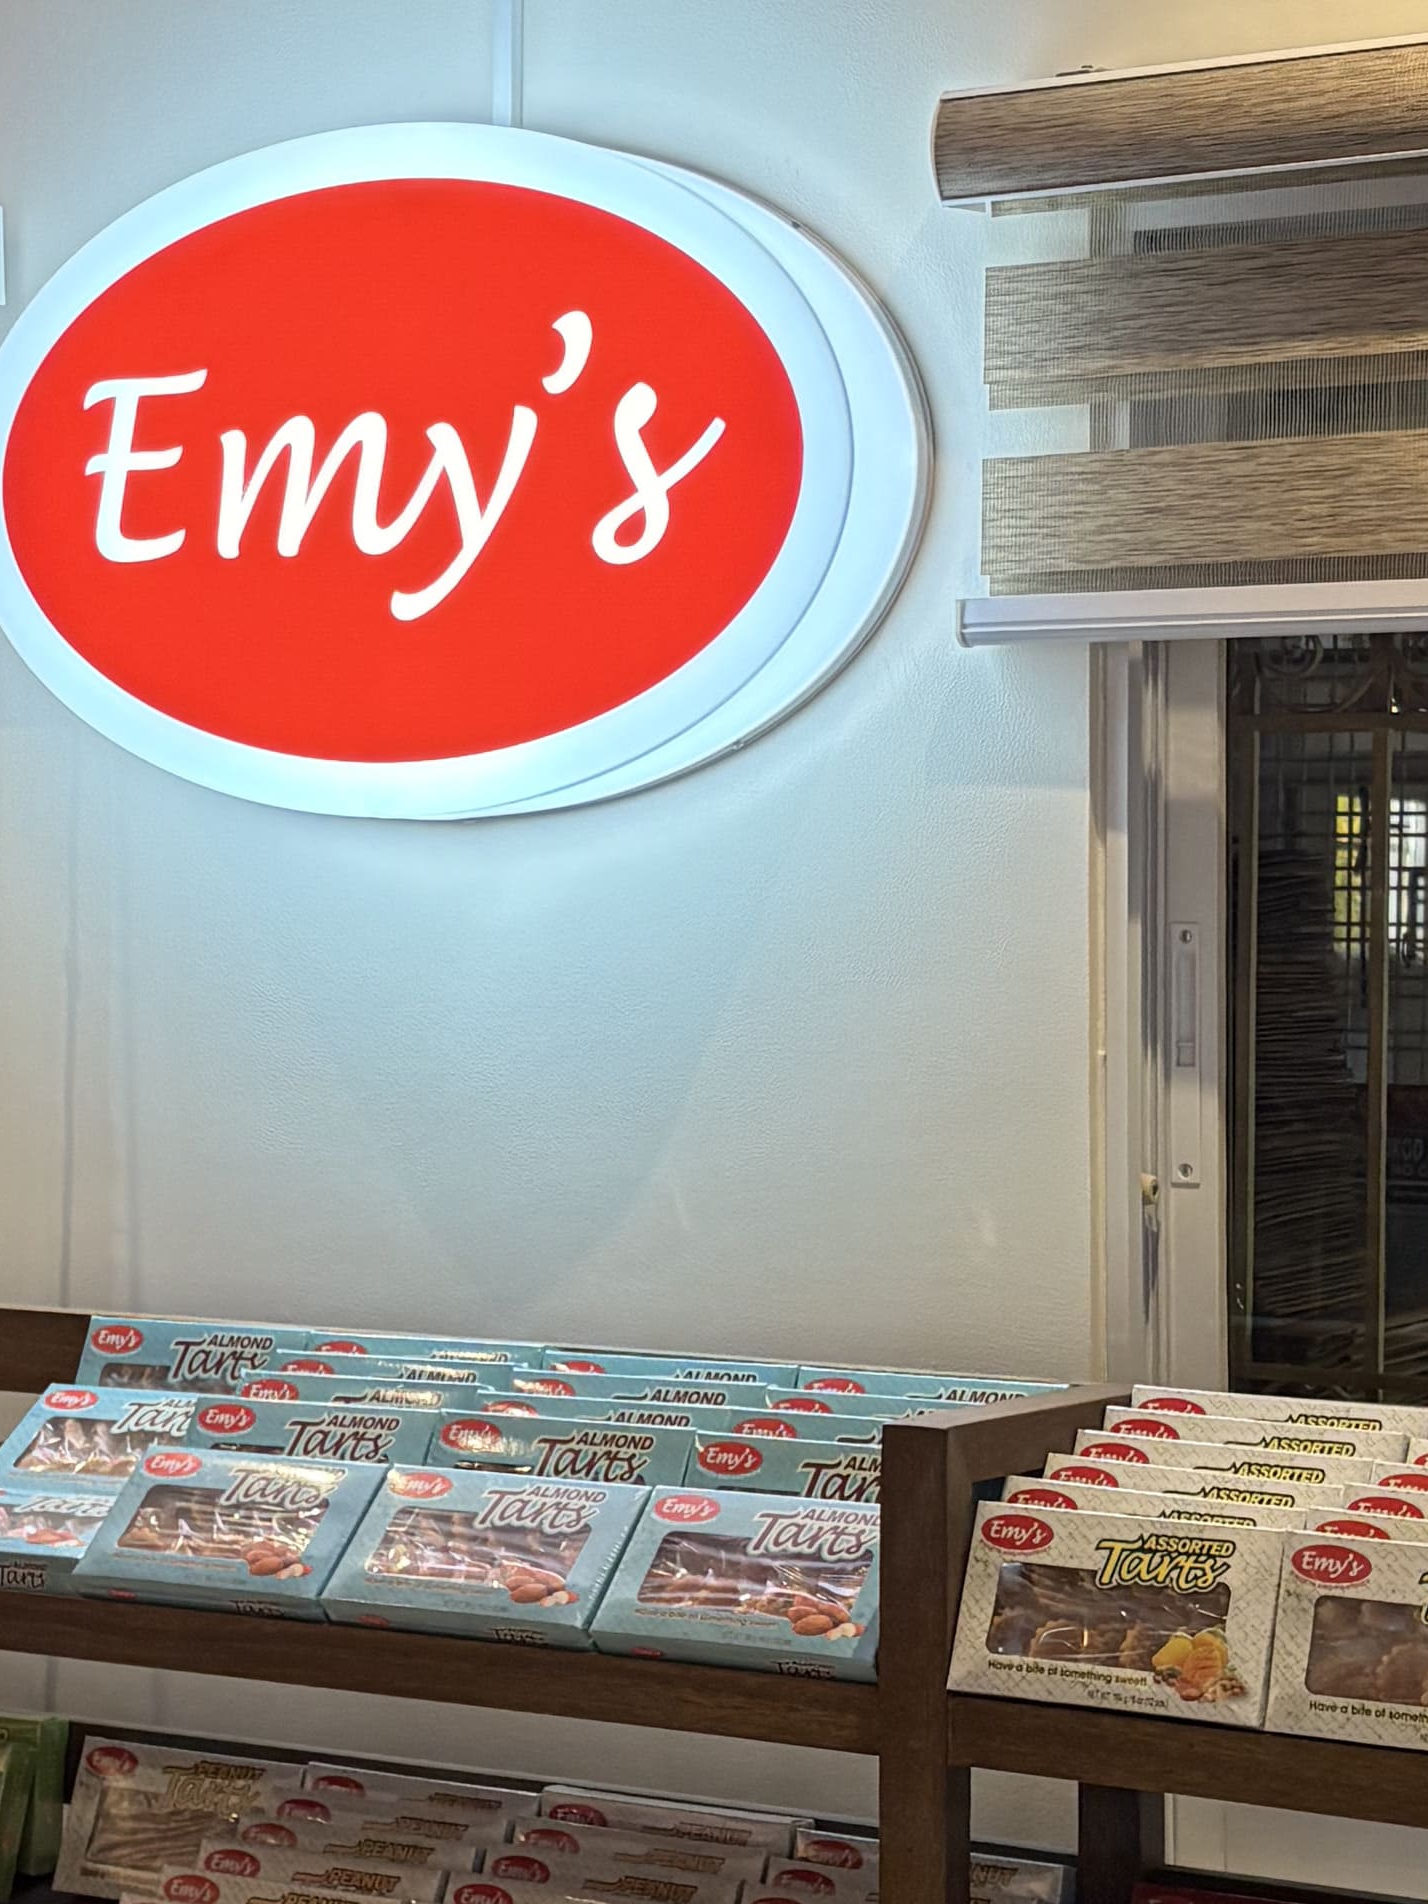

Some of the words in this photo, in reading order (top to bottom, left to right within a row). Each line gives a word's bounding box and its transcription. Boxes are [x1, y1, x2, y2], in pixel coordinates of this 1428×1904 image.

[83, 309, 726, 622] Emy's
[98, 1329, 138, 1349] Emy's
[208, 1335, 273, 1351] ALMOND
[52, 1390, 91, 1407] Emy's
[649, 1389, 726, 1406] ALMOND
[205, 1410, 247, 1427] Emy's
[326, 1415, 400, 1431] ALMOND
[287, 1421, 393, 1461] Tarts
[574, 1434, 654, 1451] ALMOND
[1269, 1437, 1355, 1457] ASSORTED
[151, 1458, 195, 1473] Emy's
[533, 1437, 650, 1483] Tarts
[704, 1447, 757, 1469] Emy's
[1238, 1463, 1324, 1484] ASSORTED
[528, 1485, 607, 1504] ALMOND
[1207, 1488, 1294, 1508] ASSORTED
[475, 1490, 600, 1531] Tarts
[661, 1501, 714, 1518] Emy's
[751, 1512, 877, 1556] Tarts
[991, 1519, 1047, 1544] Emy's
[1144, 1535, 1234, 1556] ASSORTED
[1098, 1540, 1230, 1591] Tarts
[1301, 1550, 1363, 1577] Emy's
[988, 1660, 1013, 1672] Have
[1026, 1663, 1044, 1674] bite
[1060, 1667, 1112, 1685] something
[1309, 1700, 1338, 1713] Have
[1351, 1703, 1371, 1716] bite
[210, 1854, 255, 1875] Emy's
[329, 1868, 401, 1892] PEANUT
[169, 1880, 213, 1902] Emy's
